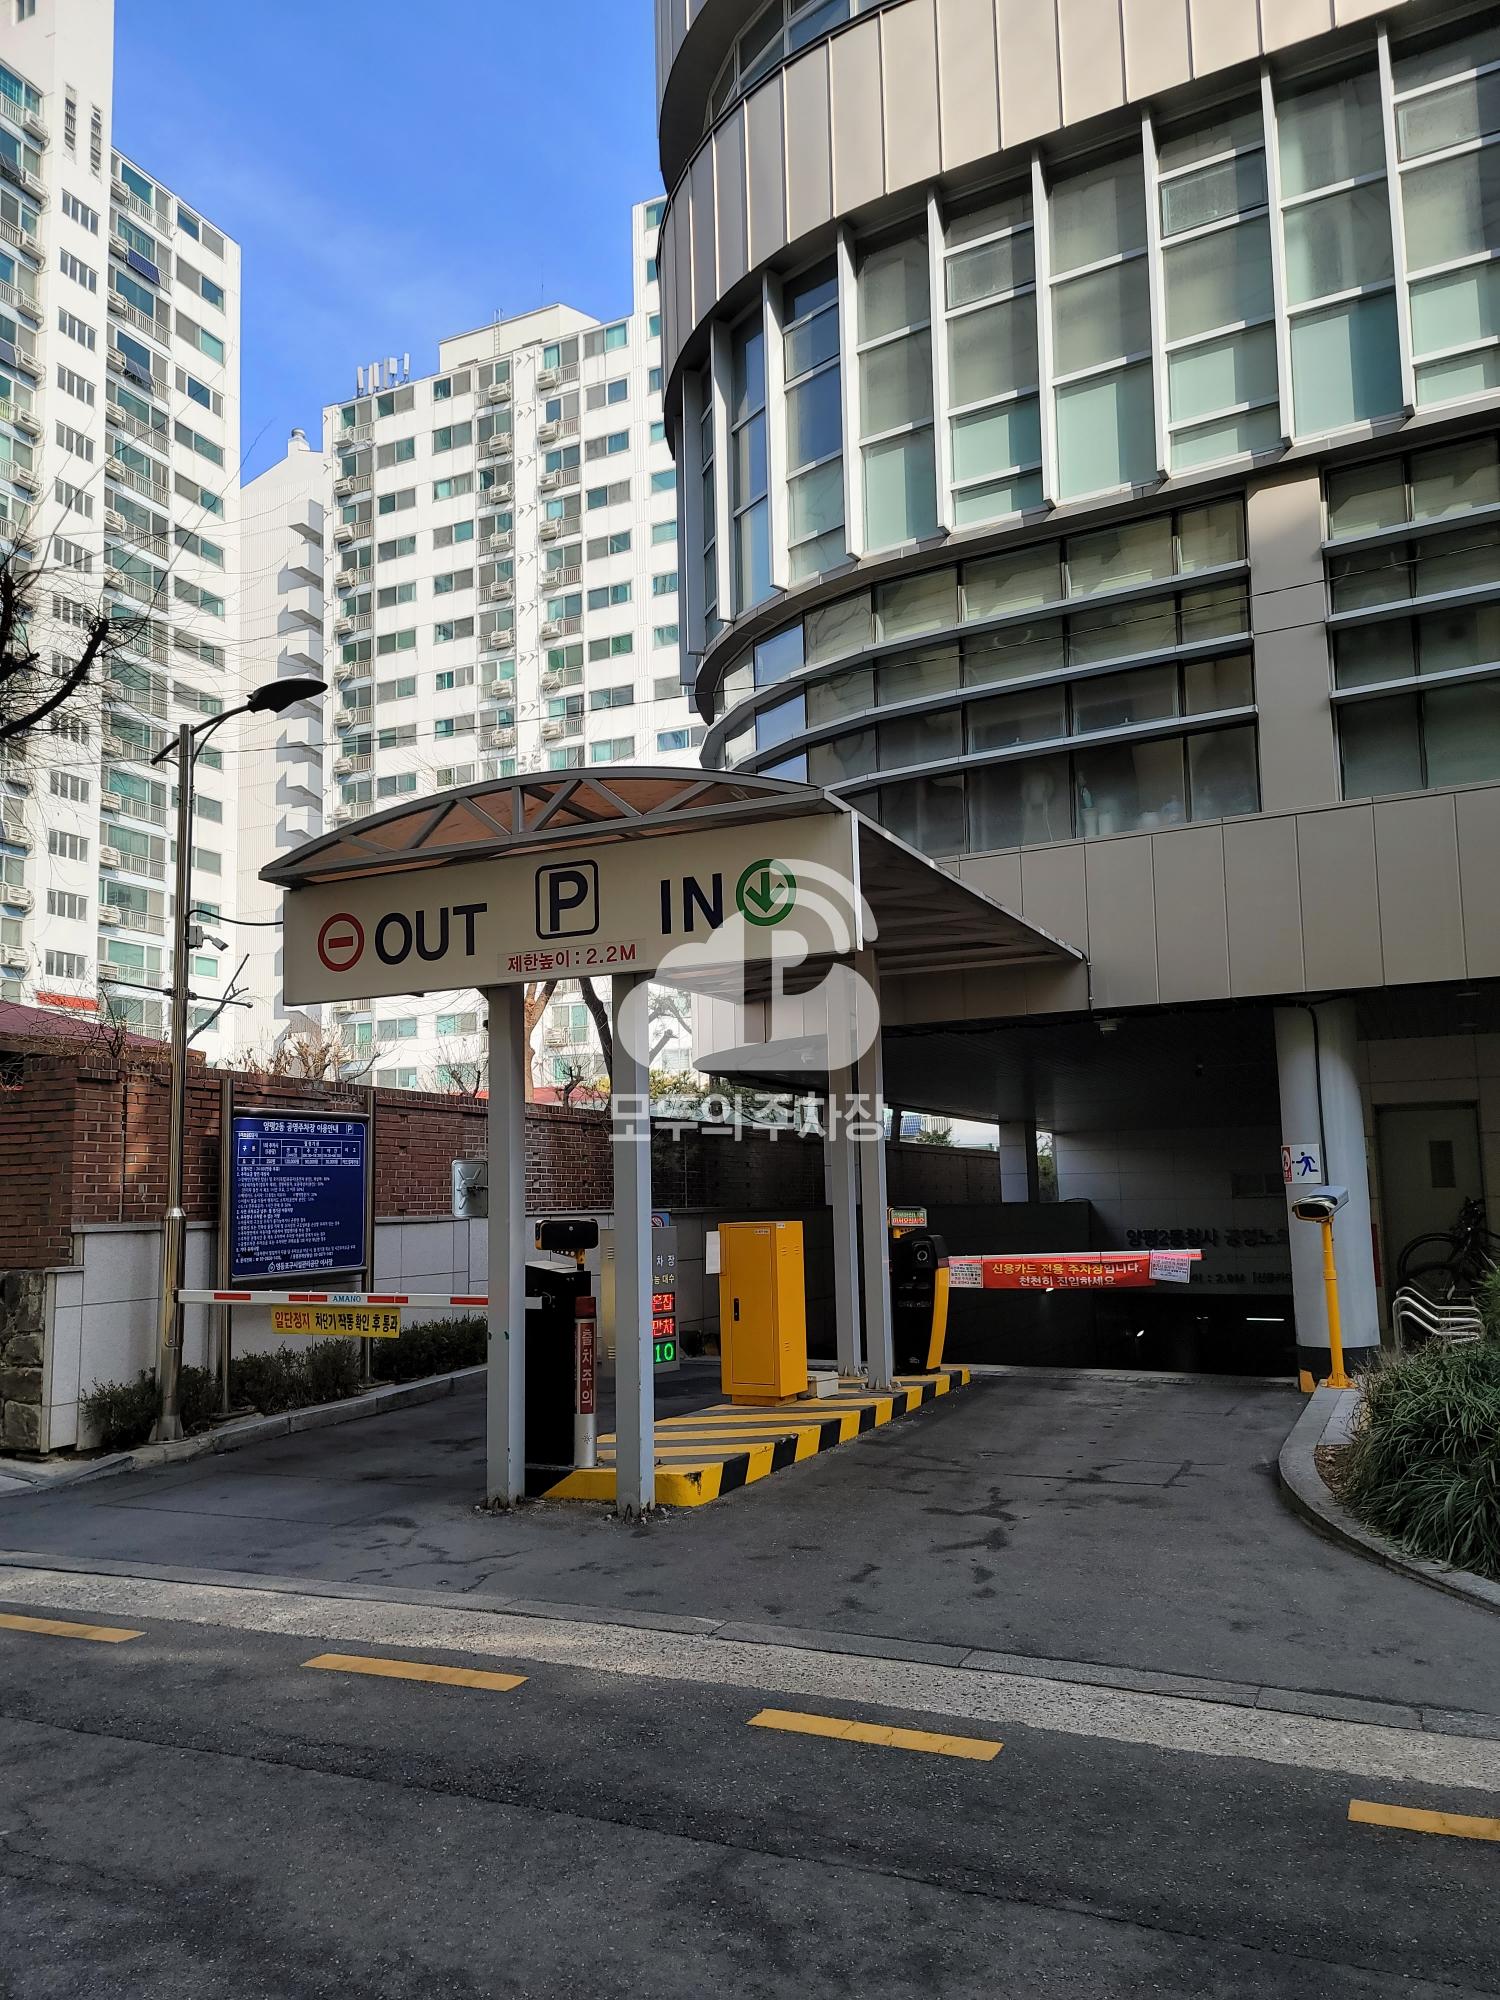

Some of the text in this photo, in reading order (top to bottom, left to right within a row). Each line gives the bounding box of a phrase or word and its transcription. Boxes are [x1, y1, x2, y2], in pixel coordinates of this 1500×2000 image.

[549, 870, 588, 932] P
[661, 873, 723, 935] IN
[374, 903, 487, 965] OUT
[507, 949, 569, 972] 제한높이
[286, 1122, 315, 1133] 공영주차장
[317, 1123, 339, 1134] 이용안내
[992, 1263, 1037, 1275] 신용카드
[1041, 1263, 1064, 1275] 전용
[1019, 1275, 1116, 1287] 천천히 진입하세요
[332, 1295, 362, 1303] AMANO
[275, 1311, 398, 1333] 일단정지 차단기 작동 확인 후 통과
[581, 1329, 593, 1406] 출차주의
